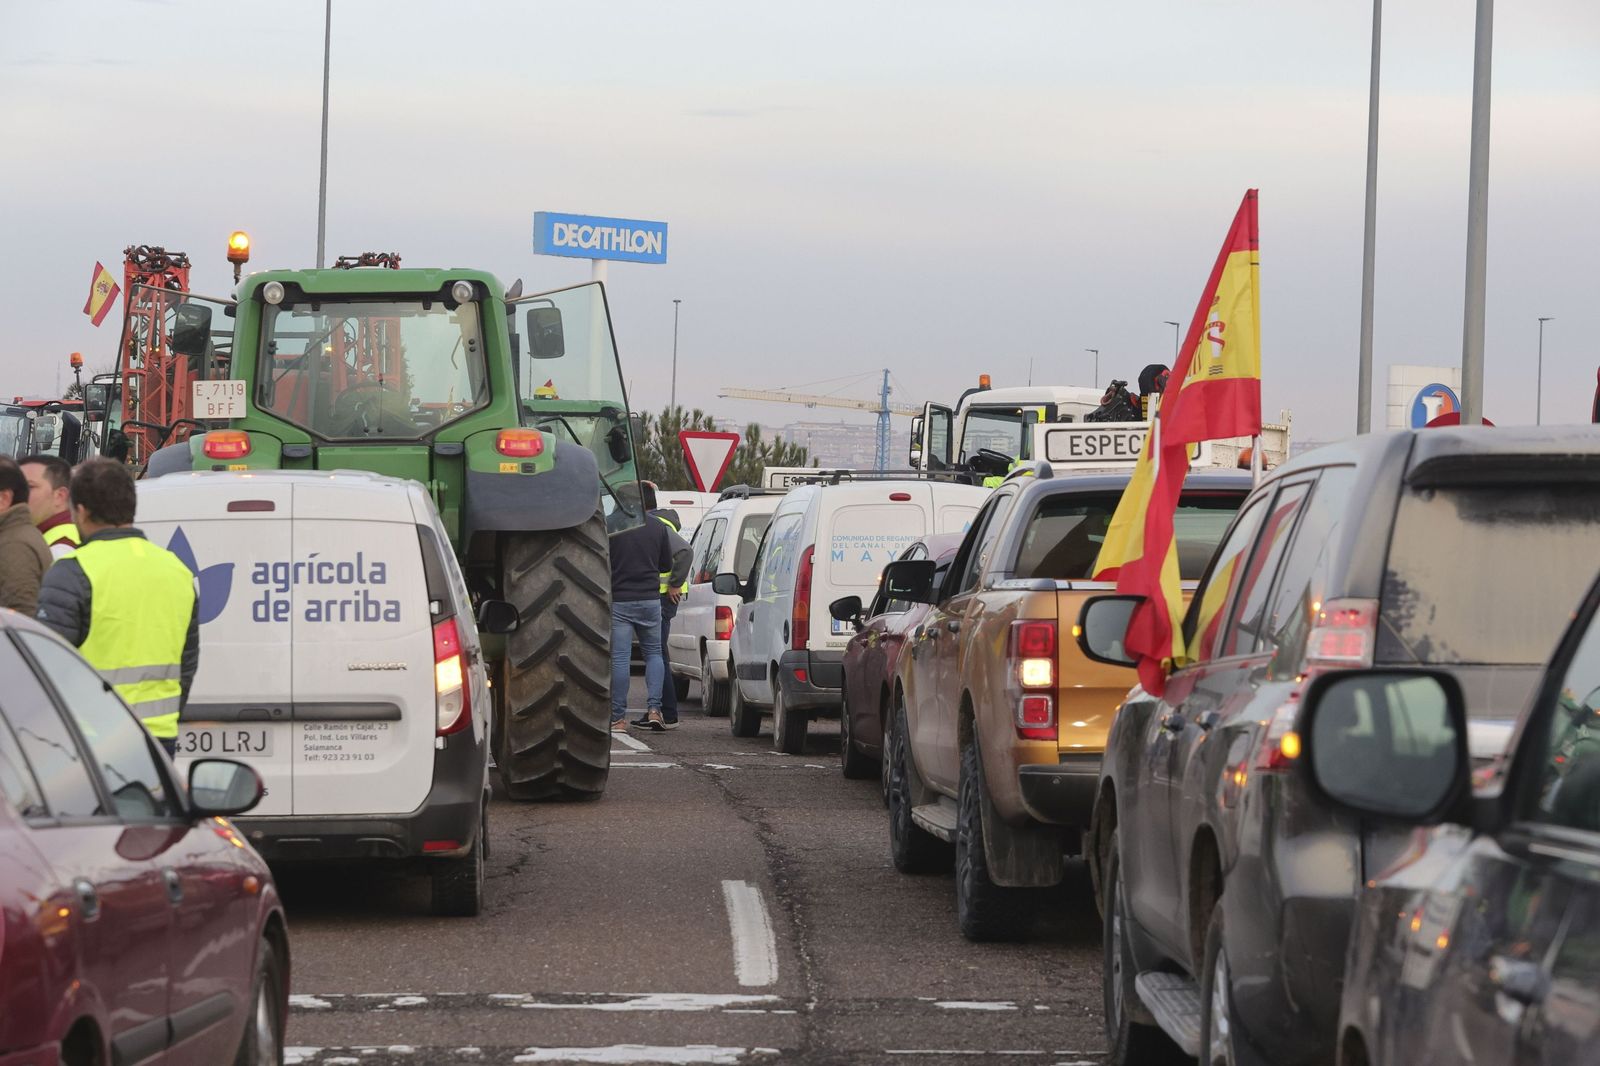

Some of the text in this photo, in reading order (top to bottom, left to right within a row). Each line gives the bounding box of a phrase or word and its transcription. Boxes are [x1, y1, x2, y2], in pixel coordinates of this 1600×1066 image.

[553, 222, 662, 255] DECATHLON
[196, 384, 244, 396] E 7119
[208, 402, 234, 416] BFF
[1070, 434, 1147, 456] ESPEC
[252, 552, 386, 593] agrícola
[252, 590, 400, 622] de arriba
[222, 730, 266, 752] LRJ
